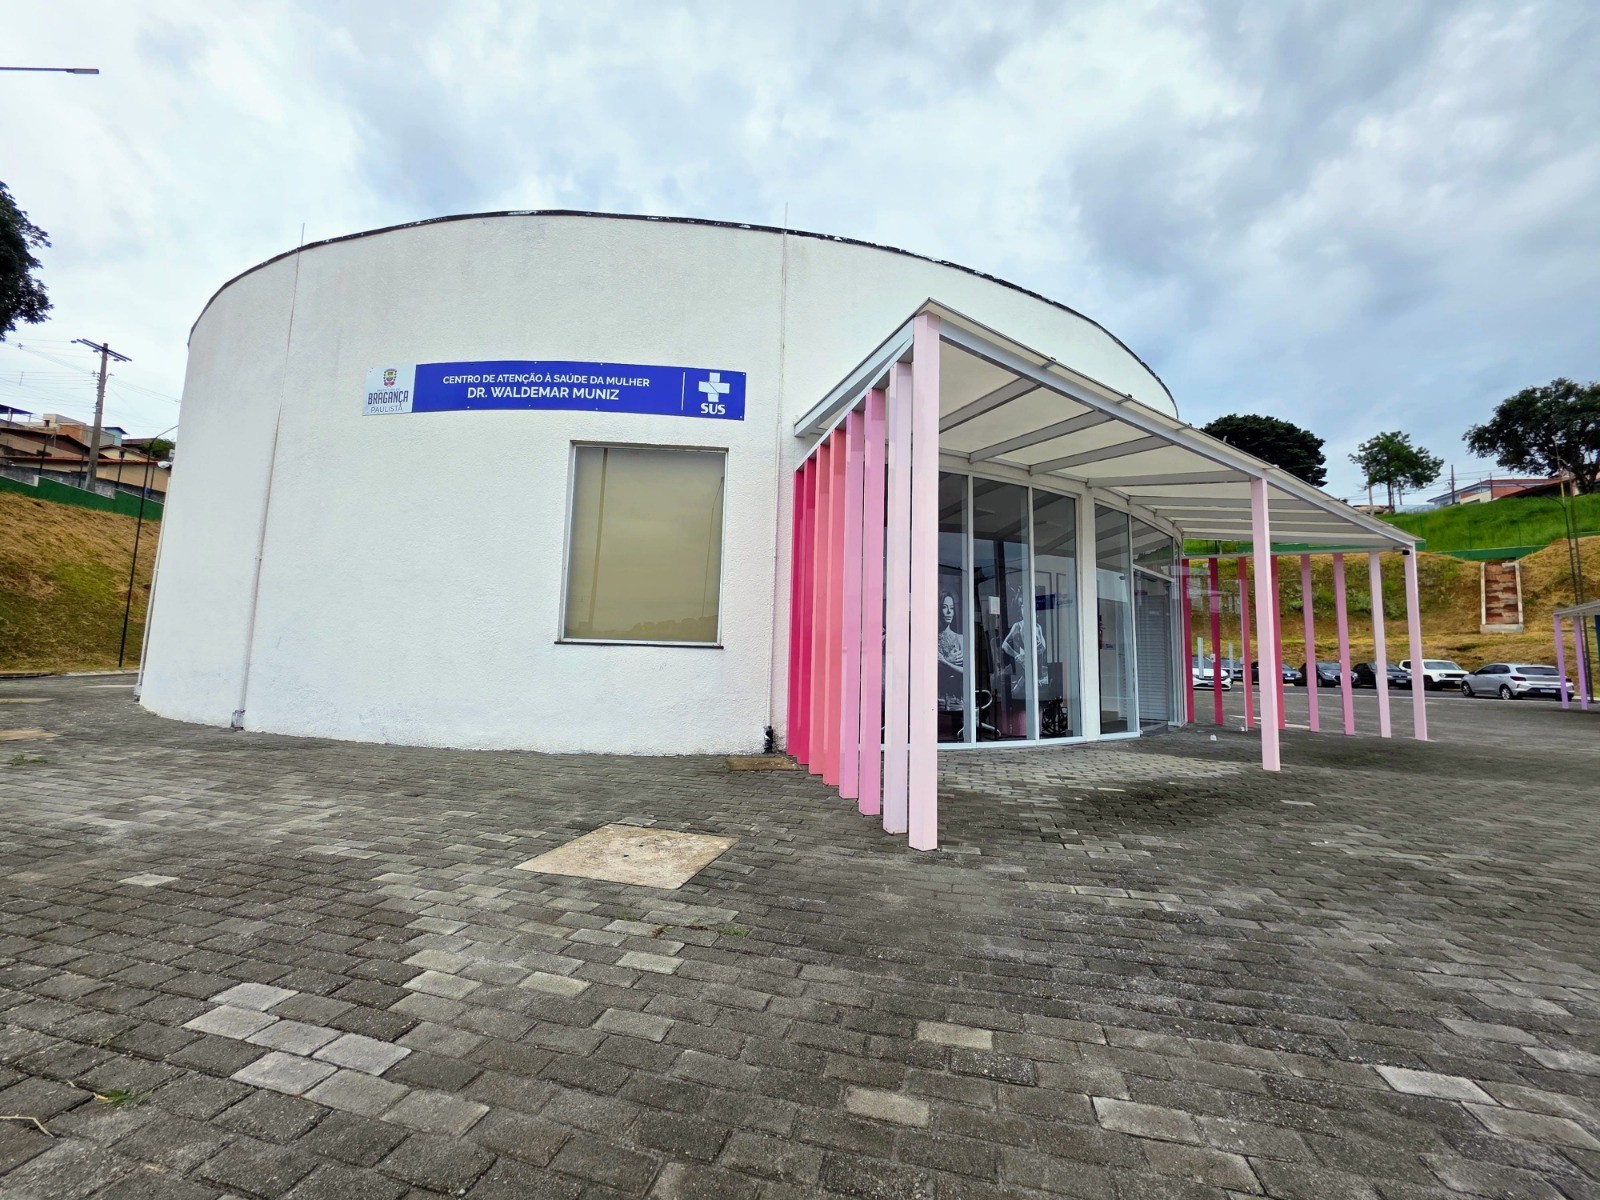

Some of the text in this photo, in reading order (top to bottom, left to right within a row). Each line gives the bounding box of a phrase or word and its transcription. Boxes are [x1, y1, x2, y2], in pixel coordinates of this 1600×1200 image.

[443, 372, 650, 387] CENTRO DE ATENÇÃO À SAÚDE DA MULHER
[367, 390, 409, 407] BRAGANÇA
[467, 386, 620, 400] DR. WALDEMAR MUNIZ
[370, 405, 403, 413] PAULISTA
[700, 402, 726, 415] SUS
